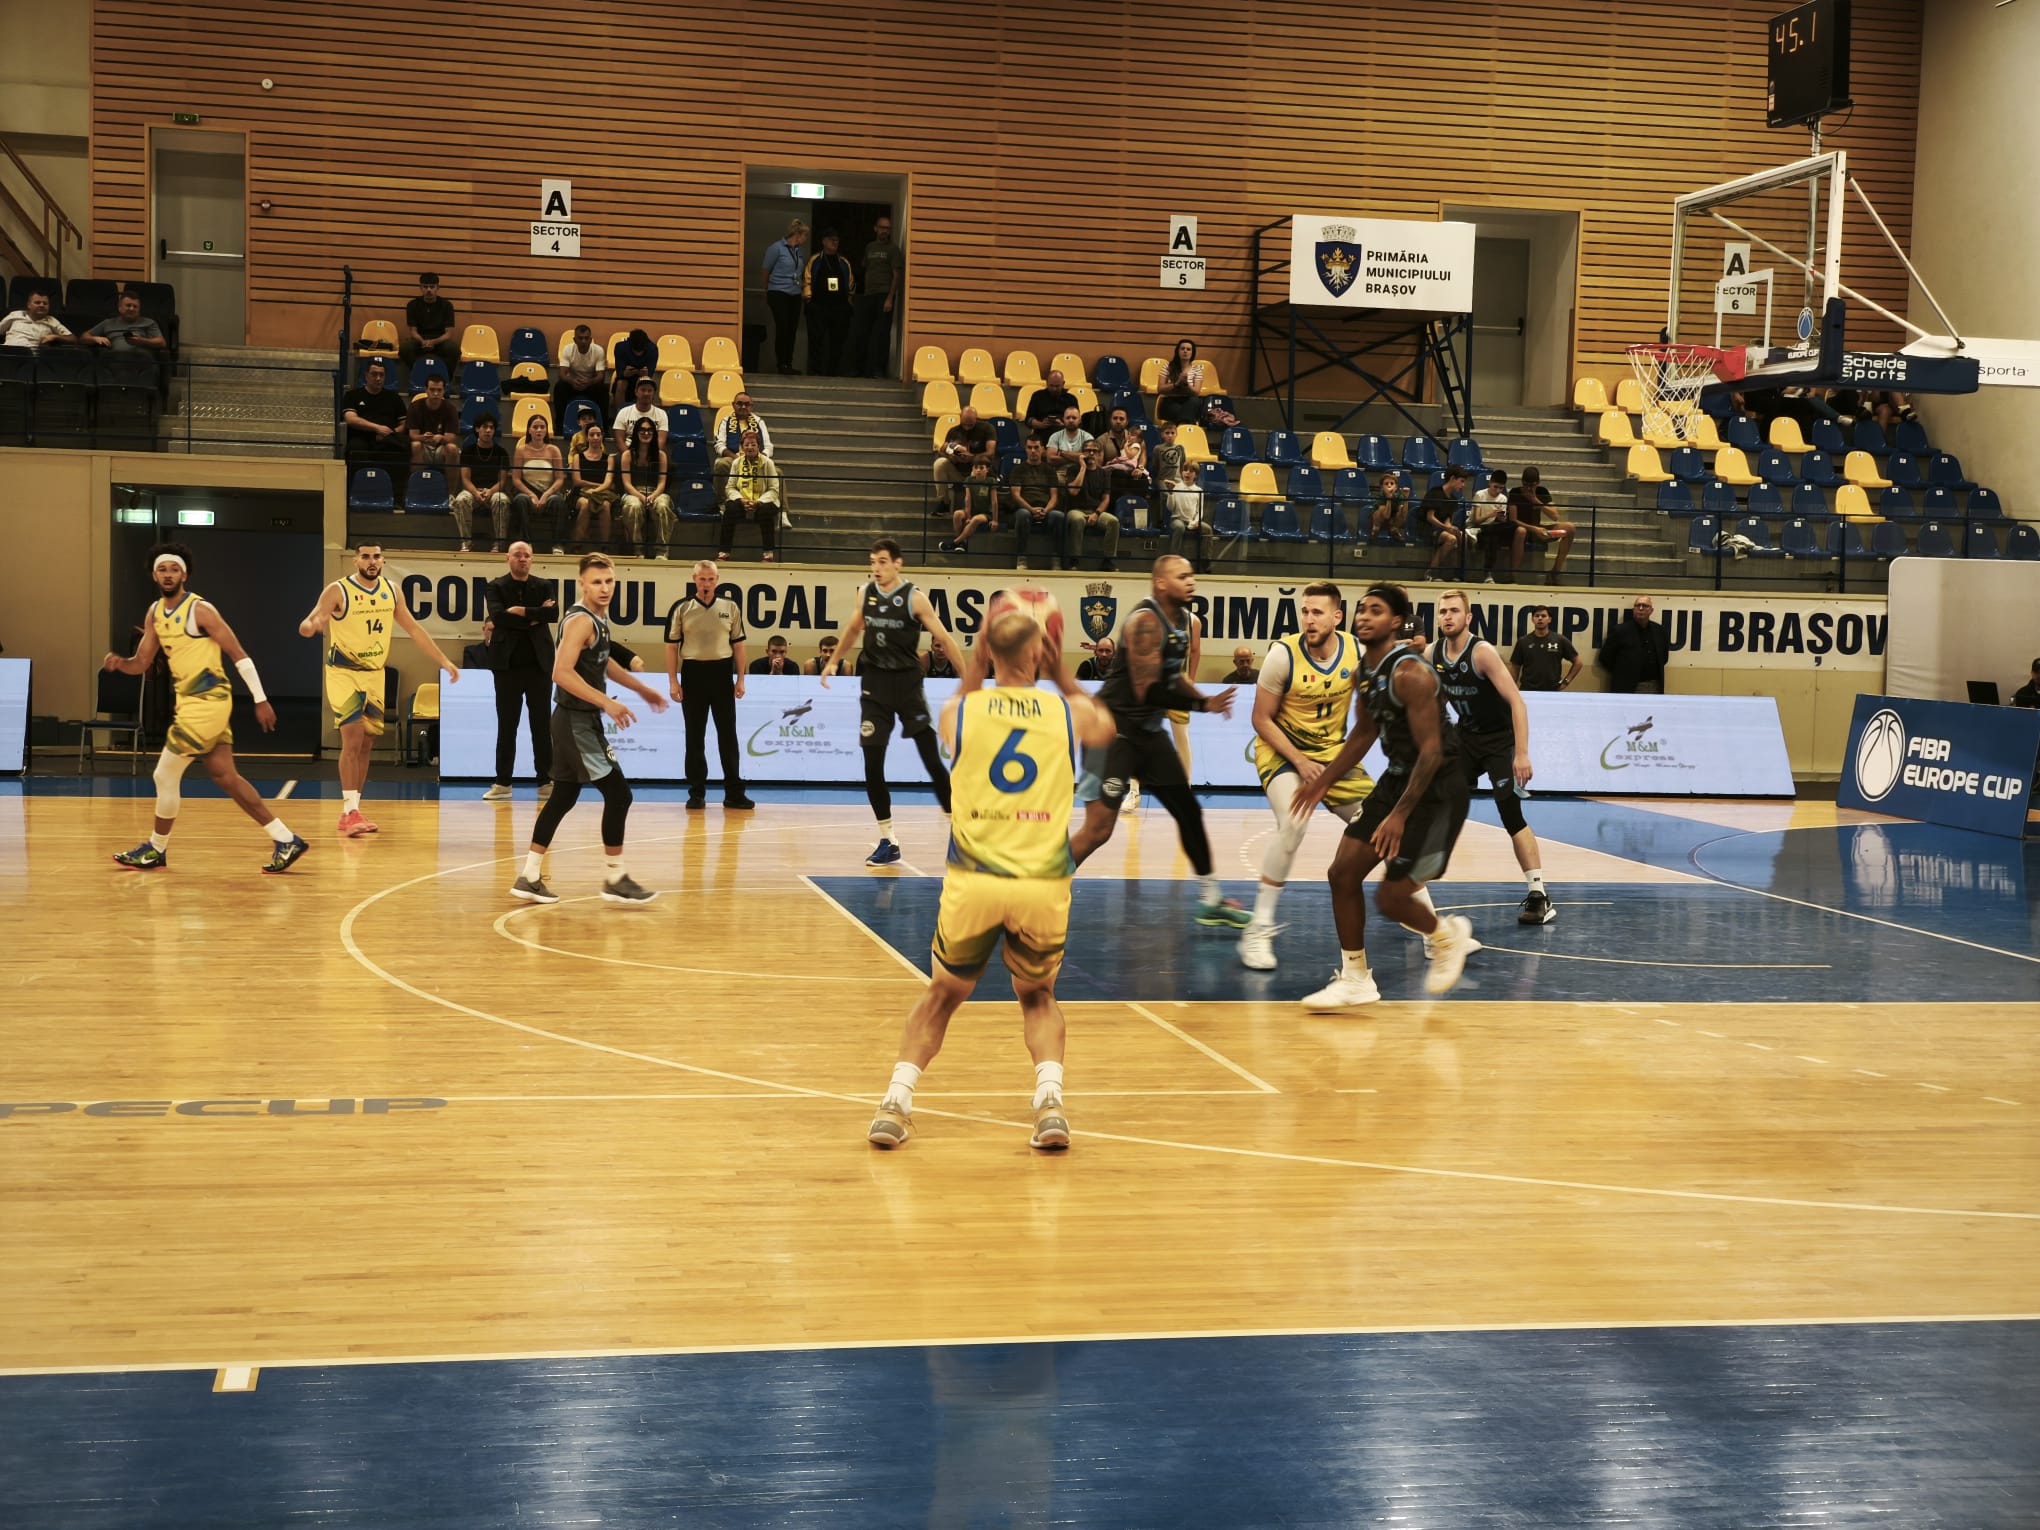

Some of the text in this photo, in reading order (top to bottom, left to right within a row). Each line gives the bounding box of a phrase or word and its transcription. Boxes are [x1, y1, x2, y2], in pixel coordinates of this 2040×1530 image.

[1775, 11, 1816, 54] 45.1
[545, 190, 568, 216] A
[532, 225, 579, 236] SECTOR
[1172, 226, 1193, 250] A
[551, 240, 560, 252] 4
[1367, 250, 1428, 263] PRIMĂRIA
[1162, 259, 1204, 270] SECTOR
[1726, 253, 1745, 276] A
[1179, 273, 1187, 285] 5
[1366, 267, 1451, 281] MUNICIPIULUI
[1366, 283, 1416, 297] BRAȘOV
[1731, 299, 1740, 310] 6
[1842, 354, 1907, 370] Schelde
[1841, 366, 1907, 381] Sports
[686, 582, 838, 630] CAL
[366, 619, 383, 634] 14
[876, 632, 887, 648] 8
[1718, 611, 1888, 666] BRAȘOV
[1316, 702, 1333, 719] 11
[779, 725, 815, 737] M&M
[1626, 741, 1659, 752] M&M
[1907, 737, 1951, 762] FIBA
[989, 728, 1038, 794] 6
[1903, 764, 2023, 800] EUROPE CUP
